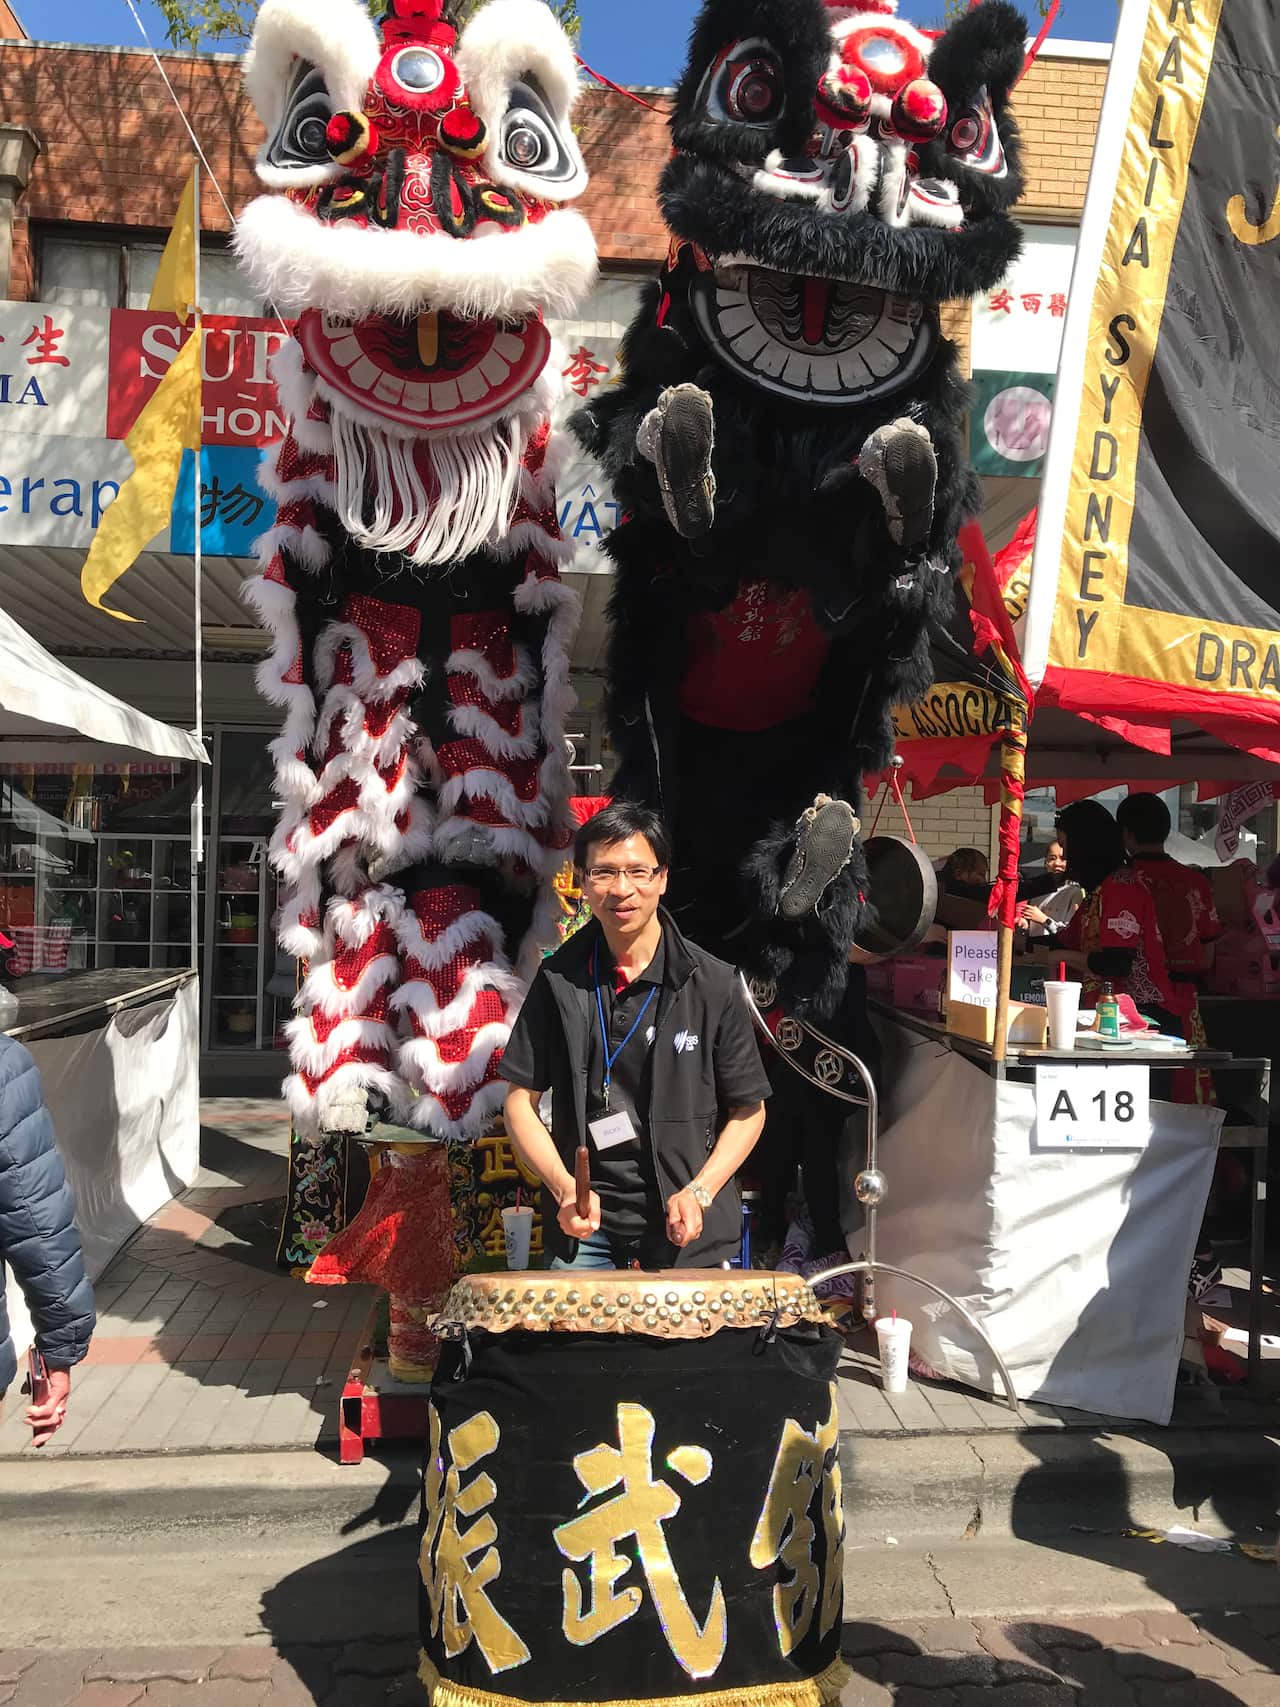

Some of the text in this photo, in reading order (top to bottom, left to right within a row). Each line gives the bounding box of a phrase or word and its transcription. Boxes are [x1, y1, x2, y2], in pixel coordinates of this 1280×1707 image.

[0, 314, 71, 367] 生
[562, 346, 610, 397] 李
[200, 476, 264, 528] 物
[1077, 314, 1136, 658] SYDNEY
[1196, 632, 1280, 692] DRA
[955, 945, 998, 960] Please
[960, 969, 993, 983] Take
[962, 993, 991, 1006] One
[1049, 1089, 1134, 1122] A 18
